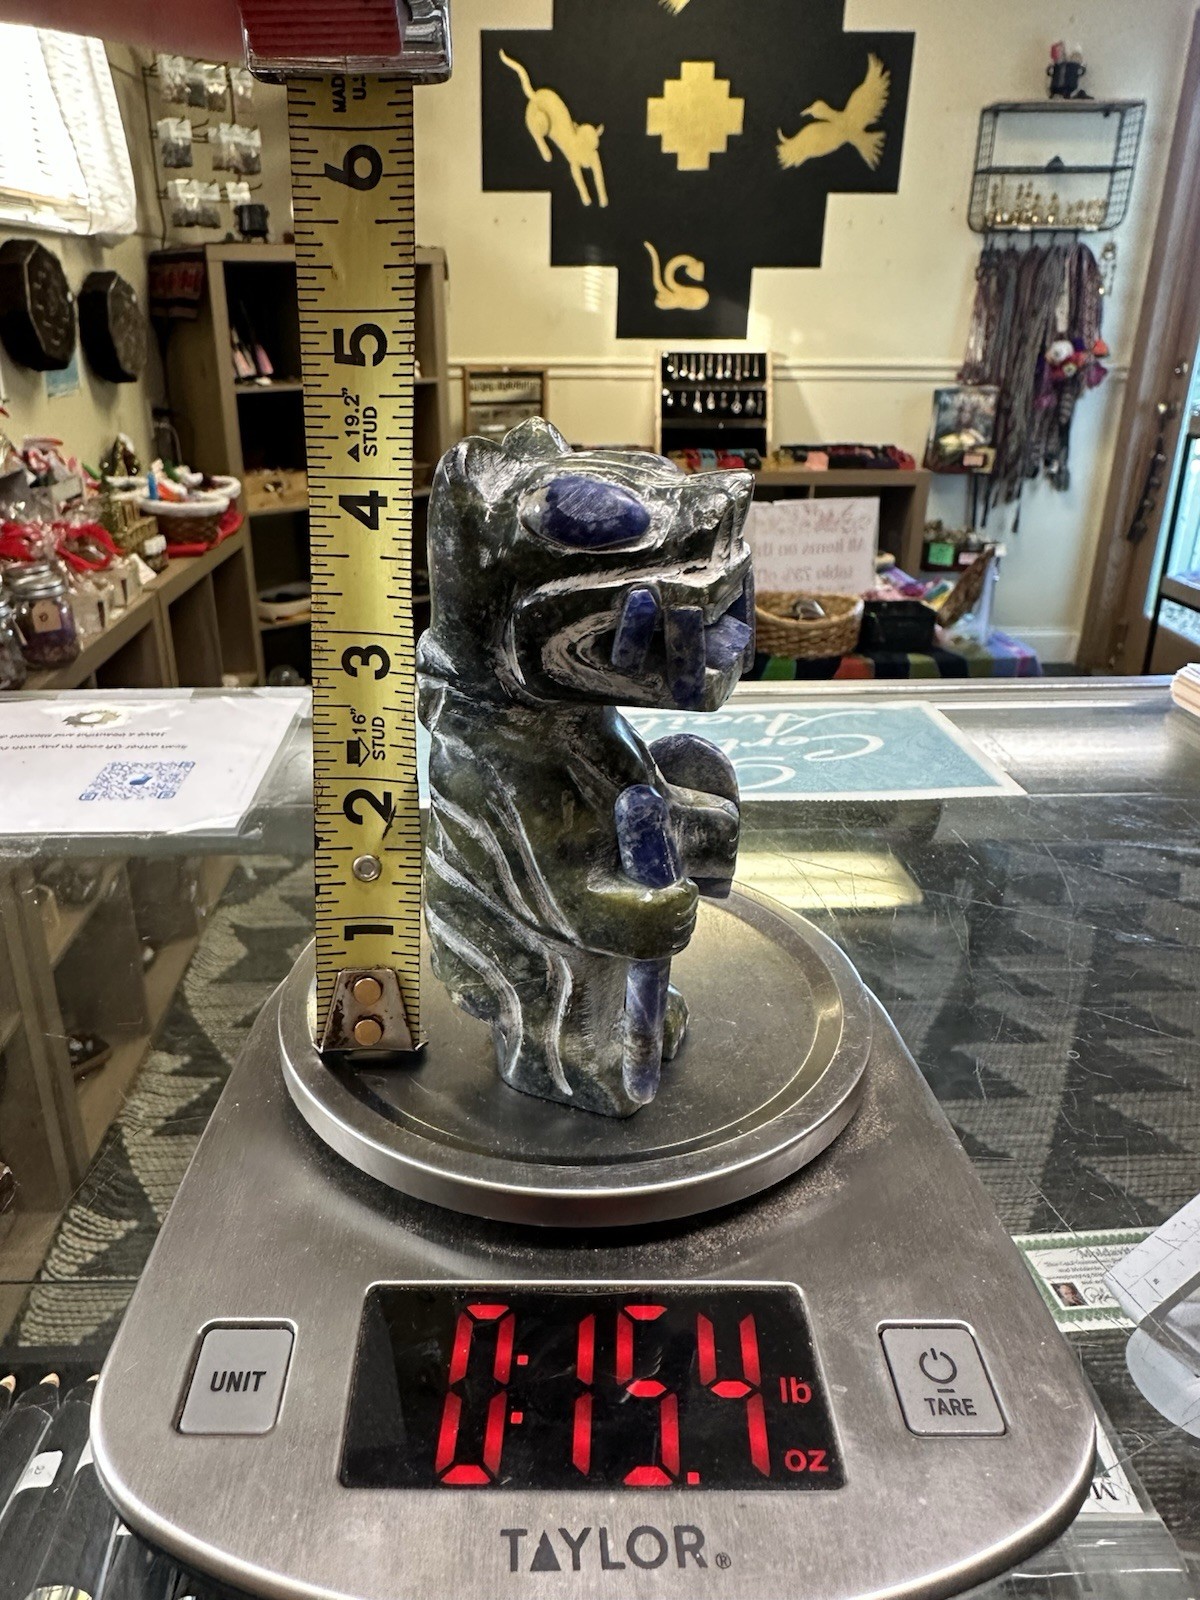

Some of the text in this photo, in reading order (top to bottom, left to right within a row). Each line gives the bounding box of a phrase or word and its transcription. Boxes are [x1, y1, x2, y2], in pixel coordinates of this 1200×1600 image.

[331, 74, 347, 113] MAD
[324, 144, 383, 191] 6
[332, 323, 388, 367] 5
[342, 387, 360, 438] 19.2"
[363, 405, 378, 457] STUD
[338, 490, 388, 531] 4
[341, 644, 391, 680] 3
[350, 708, 367, 735] 16"
[371, 716, 386, 761] STUD
[723, 733, 885, 762] Cert
[343, 788, 393, 825] 2
[344, 924, 394, 941] 1
[210, 1370, 268, 1393] UNIT
[779, 1376, 813, 1404] lb
[923, 1397, 978, 1417] TARE
[784, 1448, 829, 1473] oz
